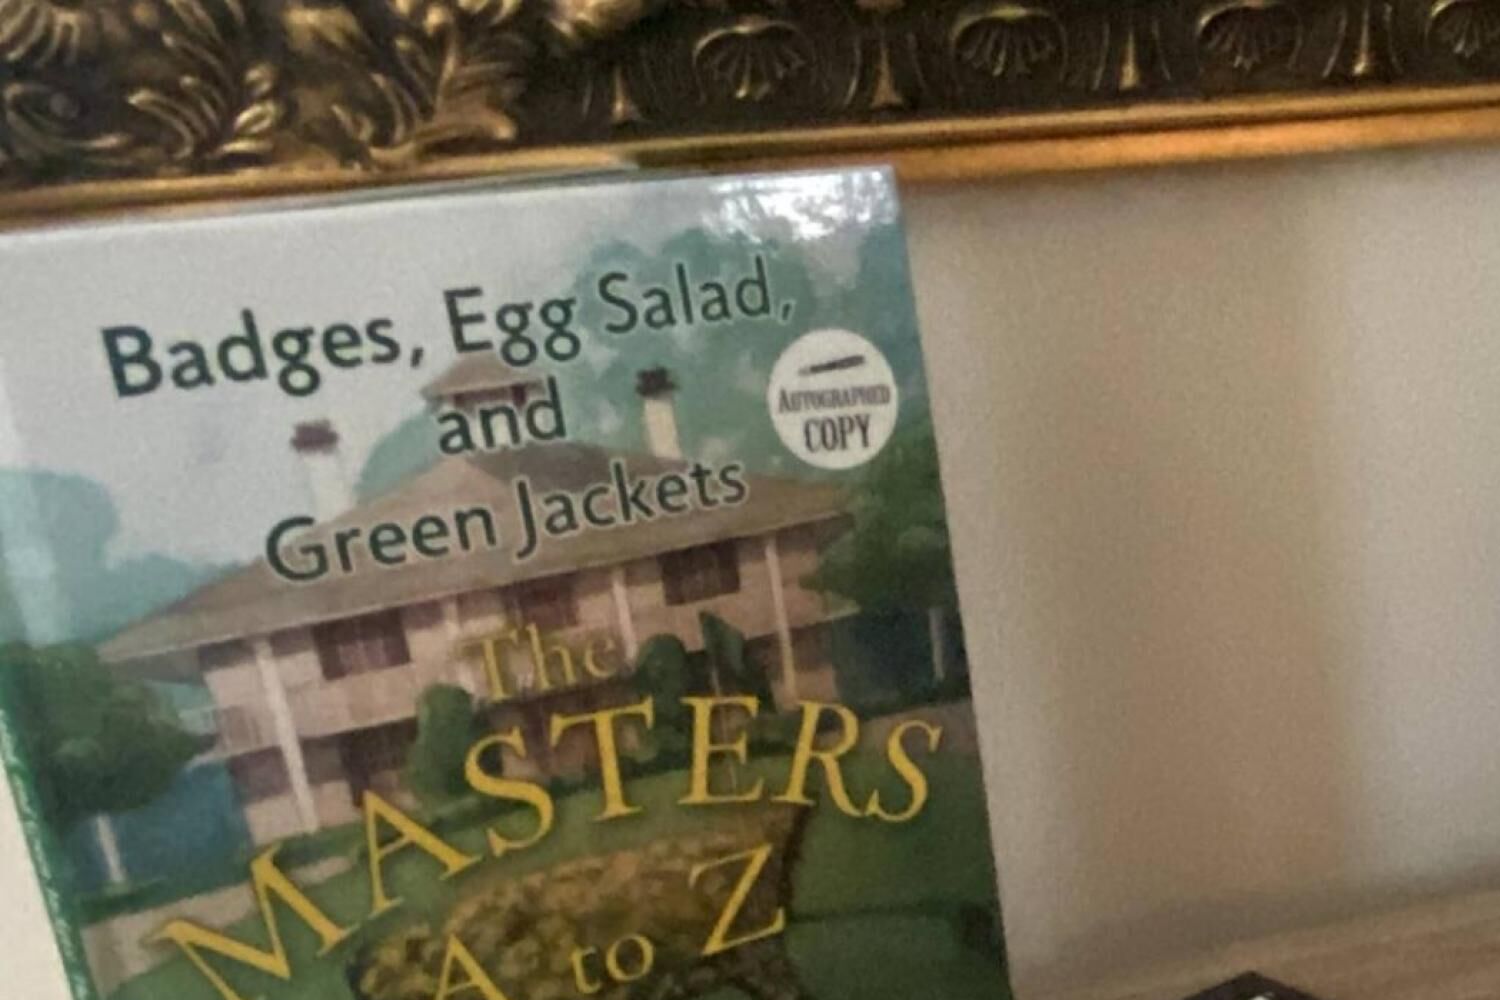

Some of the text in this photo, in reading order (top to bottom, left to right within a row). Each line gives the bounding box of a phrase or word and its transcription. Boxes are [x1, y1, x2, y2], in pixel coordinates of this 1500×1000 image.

[102, 255, 795, 398] Badges, Egg Salad,
[437, 376, 567, 456] and
[804, 415, 872, 453] COPY
[265, 458, 749, 581] Green Jackets
[474, 624, 621, 700] The
[571, 930, 654, 996] to
[689, 841, 786, 957] Z
